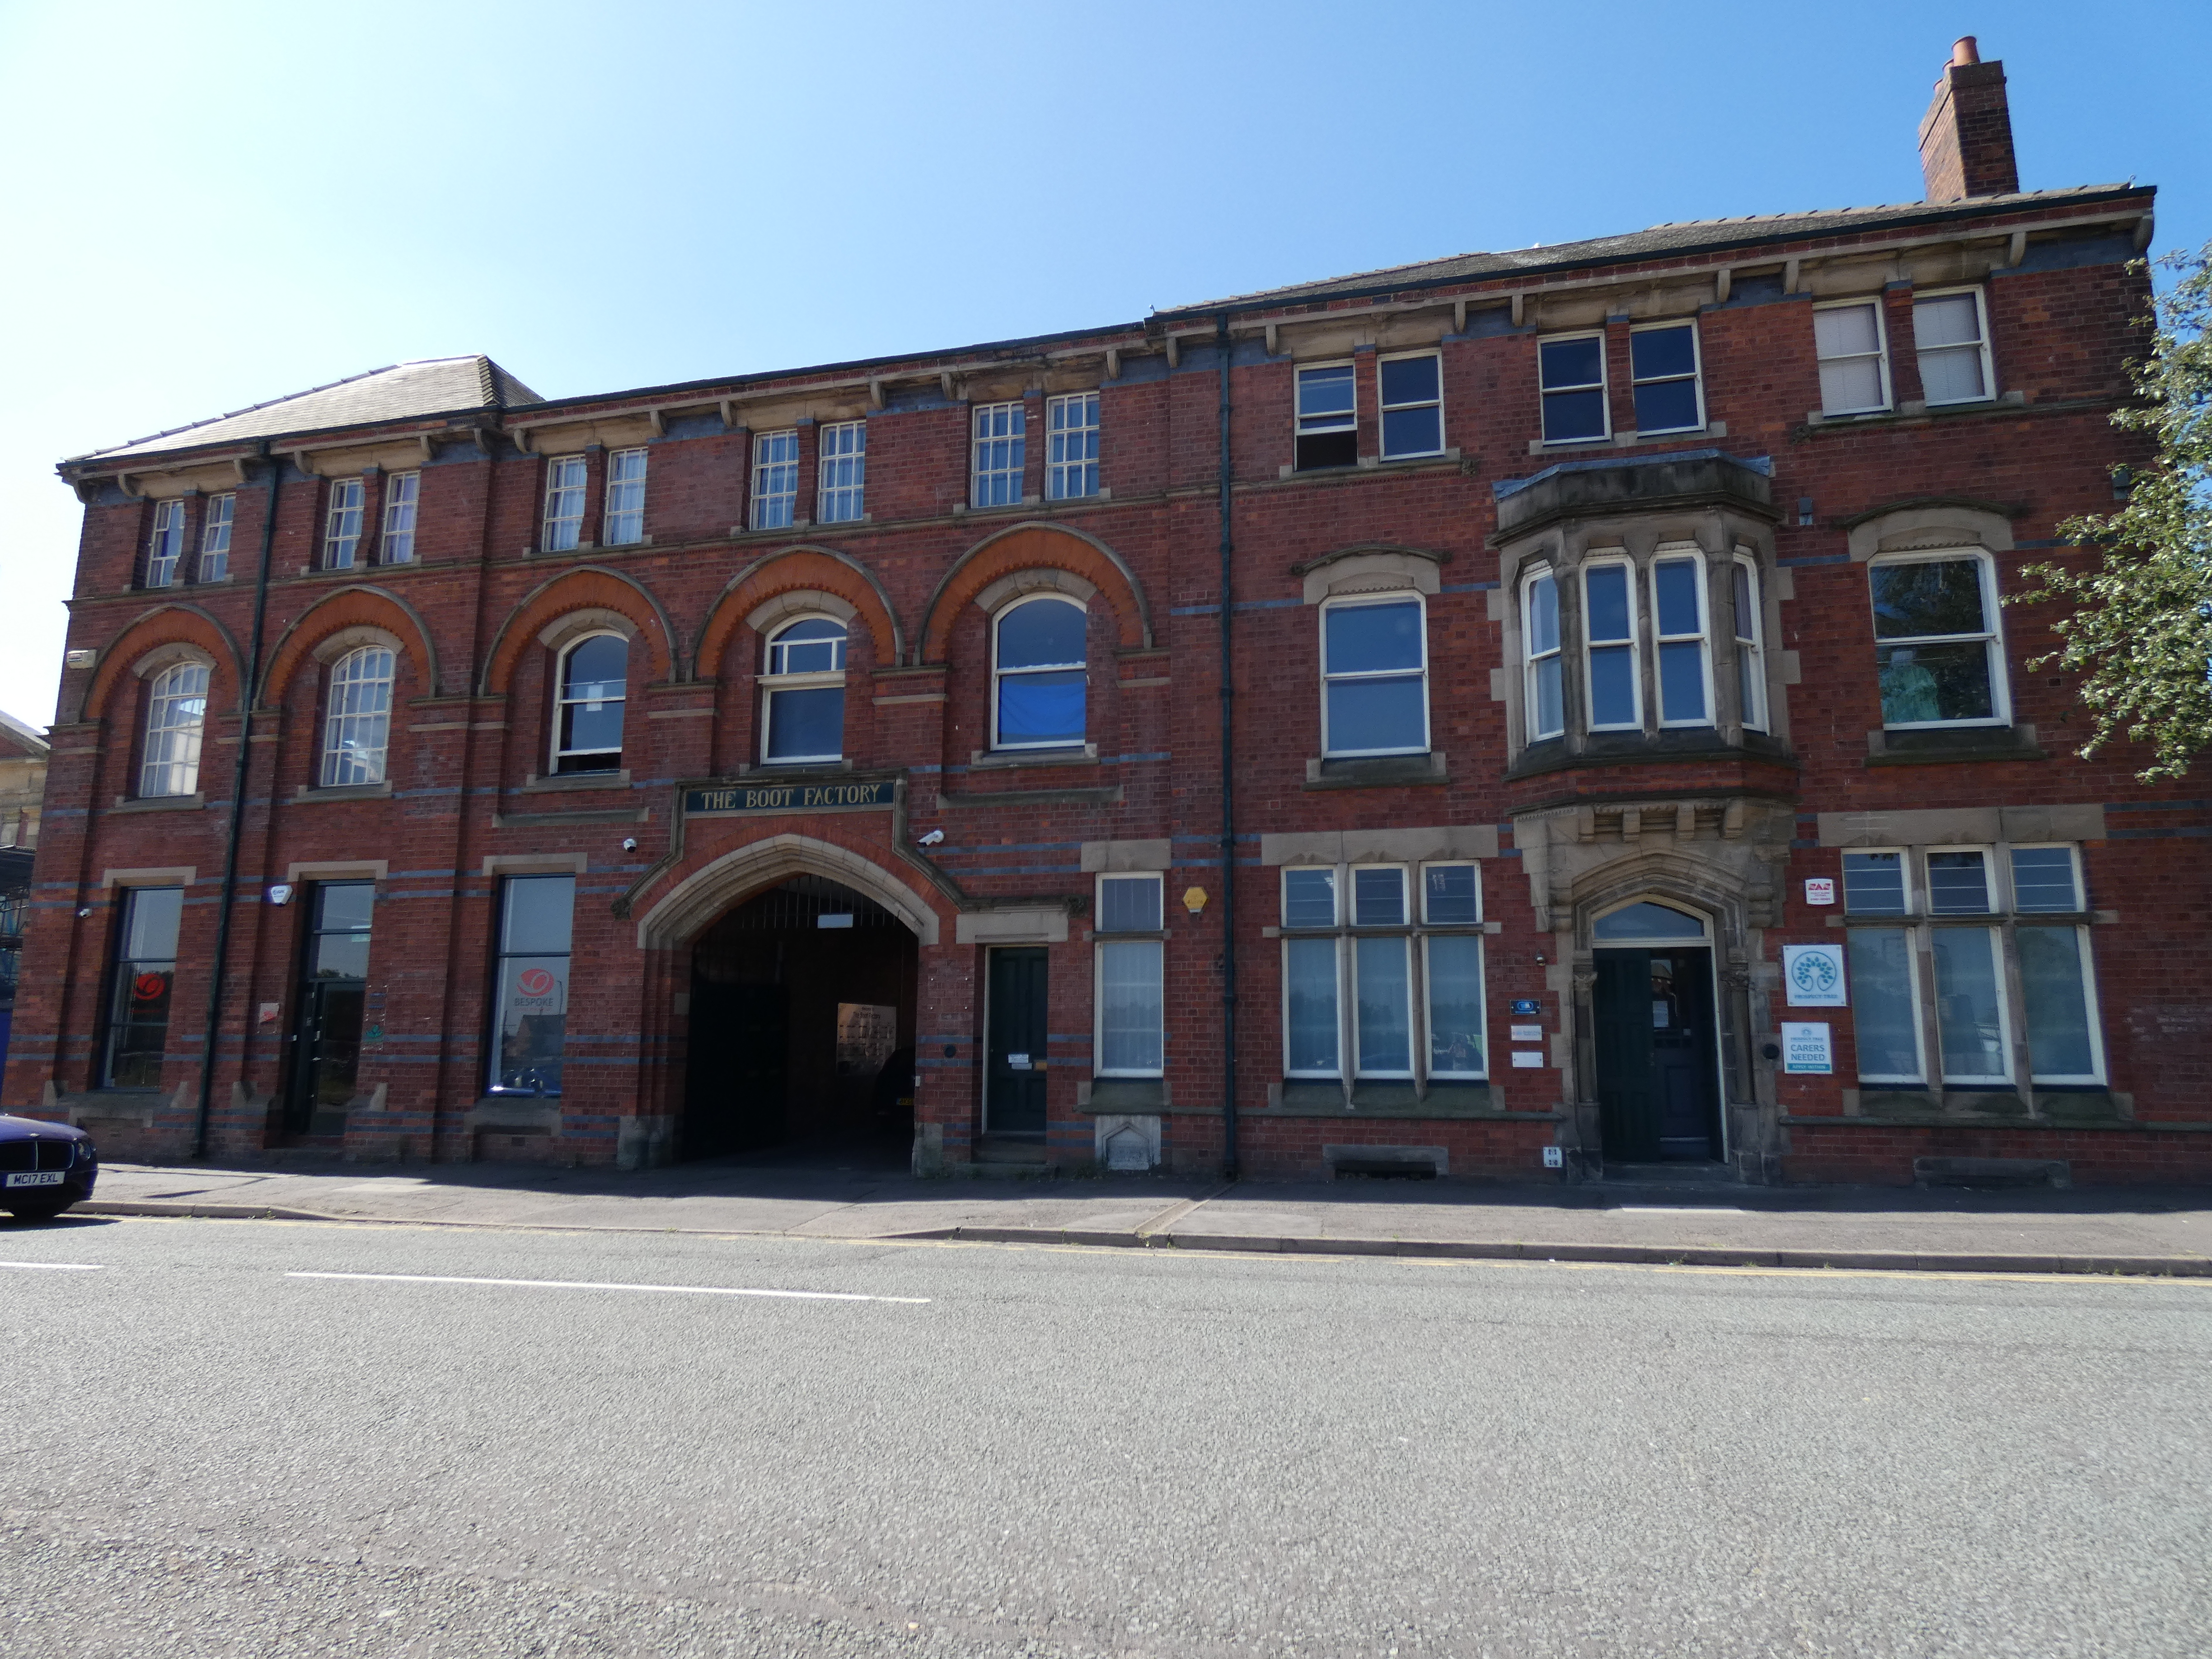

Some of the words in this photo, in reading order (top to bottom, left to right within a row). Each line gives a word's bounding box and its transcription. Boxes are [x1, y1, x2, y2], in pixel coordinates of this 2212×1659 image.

[701, 791, 736, 810] THE
[745, 789, 794, 808] BOOT
[803, 784, 880, 806] FACTORY
[514, 998, 553, 1006] BESPOKE
[14, 1174, 38, 1185] MC17
[40, 1173, 58, 1183] EXL
